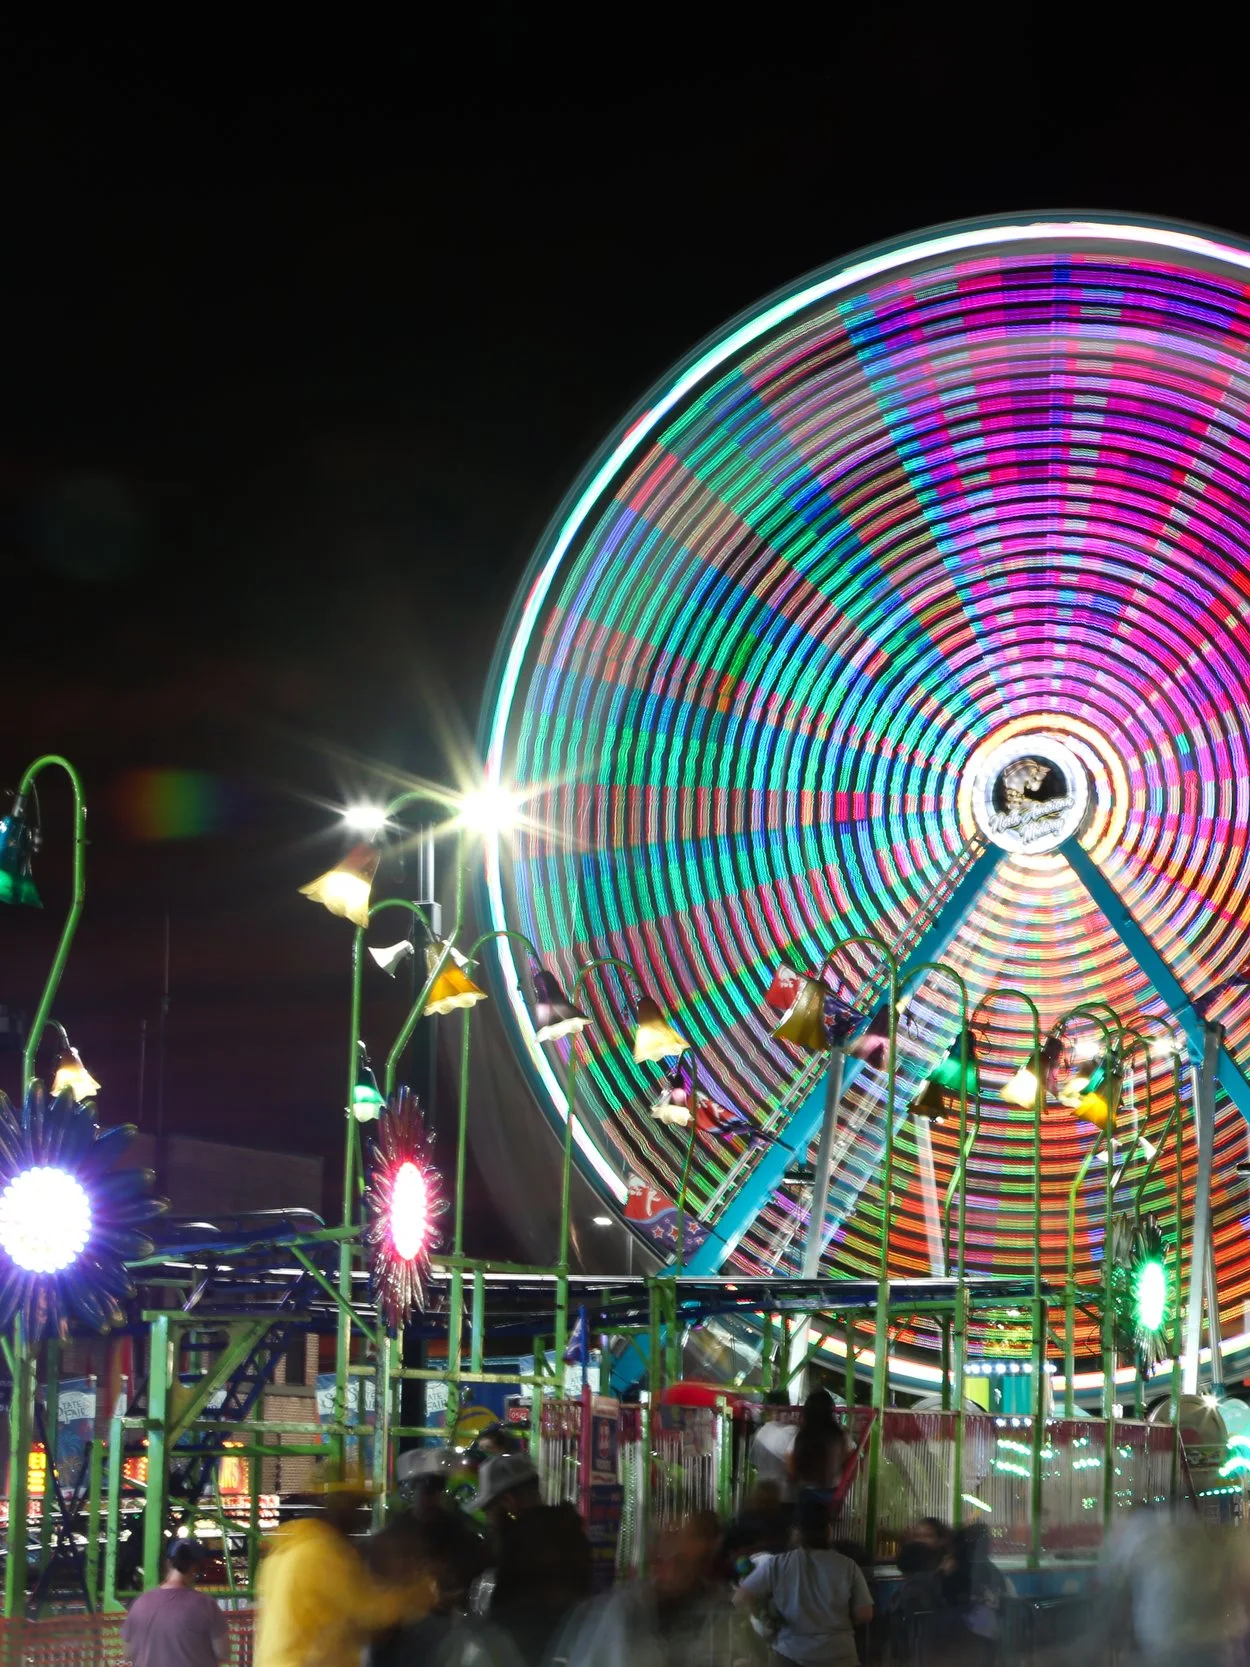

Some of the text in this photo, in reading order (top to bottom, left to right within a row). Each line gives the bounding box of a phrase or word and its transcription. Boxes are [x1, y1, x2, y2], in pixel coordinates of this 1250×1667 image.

[989, 795, 1075, 835] North American
[1020, 818, 1066, 845] Midway
